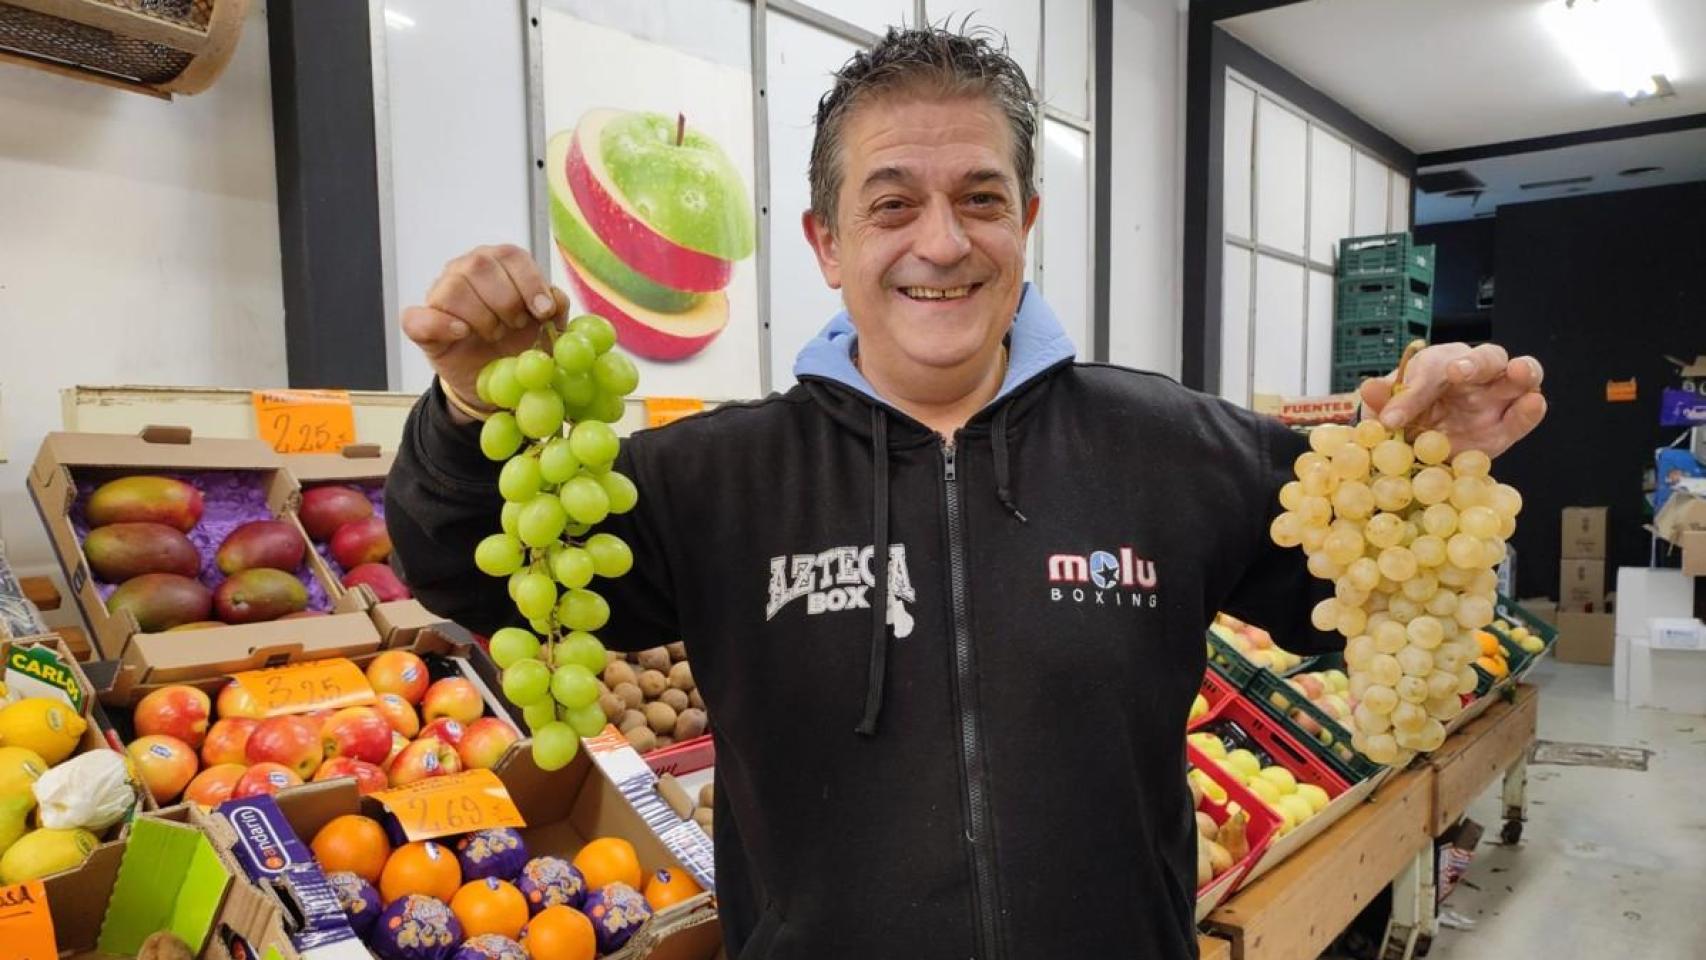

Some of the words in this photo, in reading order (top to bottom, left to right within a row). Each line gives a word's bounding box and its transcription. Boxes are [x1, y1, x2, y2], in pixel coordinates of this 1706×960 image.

[1282, 402, 1354, 414] FUENTES
[766, 543, 916, 622] AZTECA
[1048, 546, 1158, 590] molu
[807, 584, 871, 615] BOX
[1051, 587, 1158, 608] BOXING
